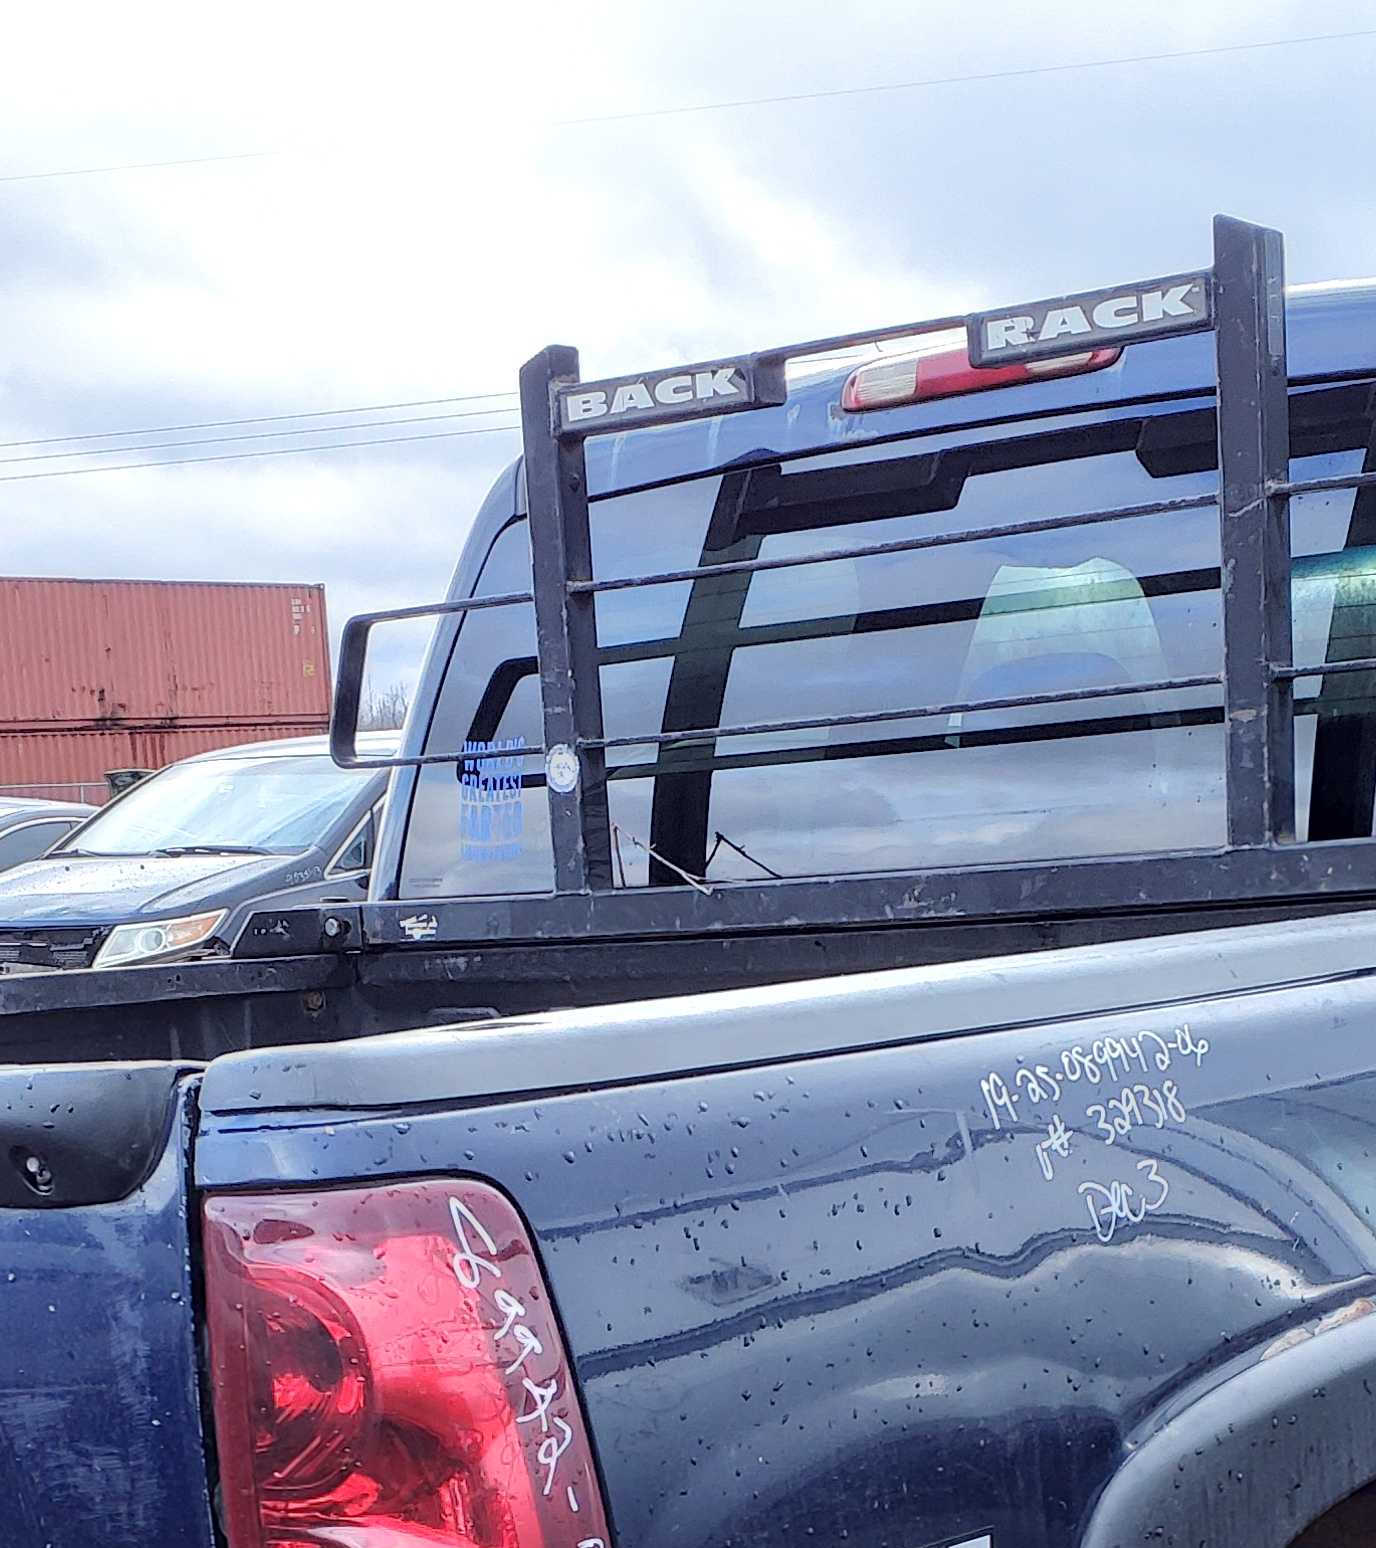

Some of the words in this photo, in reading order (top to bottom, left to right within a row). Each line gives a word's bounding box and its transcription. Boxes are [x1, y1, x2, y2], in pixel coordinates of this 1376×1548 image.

[566, 367, 739, 422] BACK
[986, 283, 1194, 351] RACK
[1085, 1079, 1186, 1145] 329318
